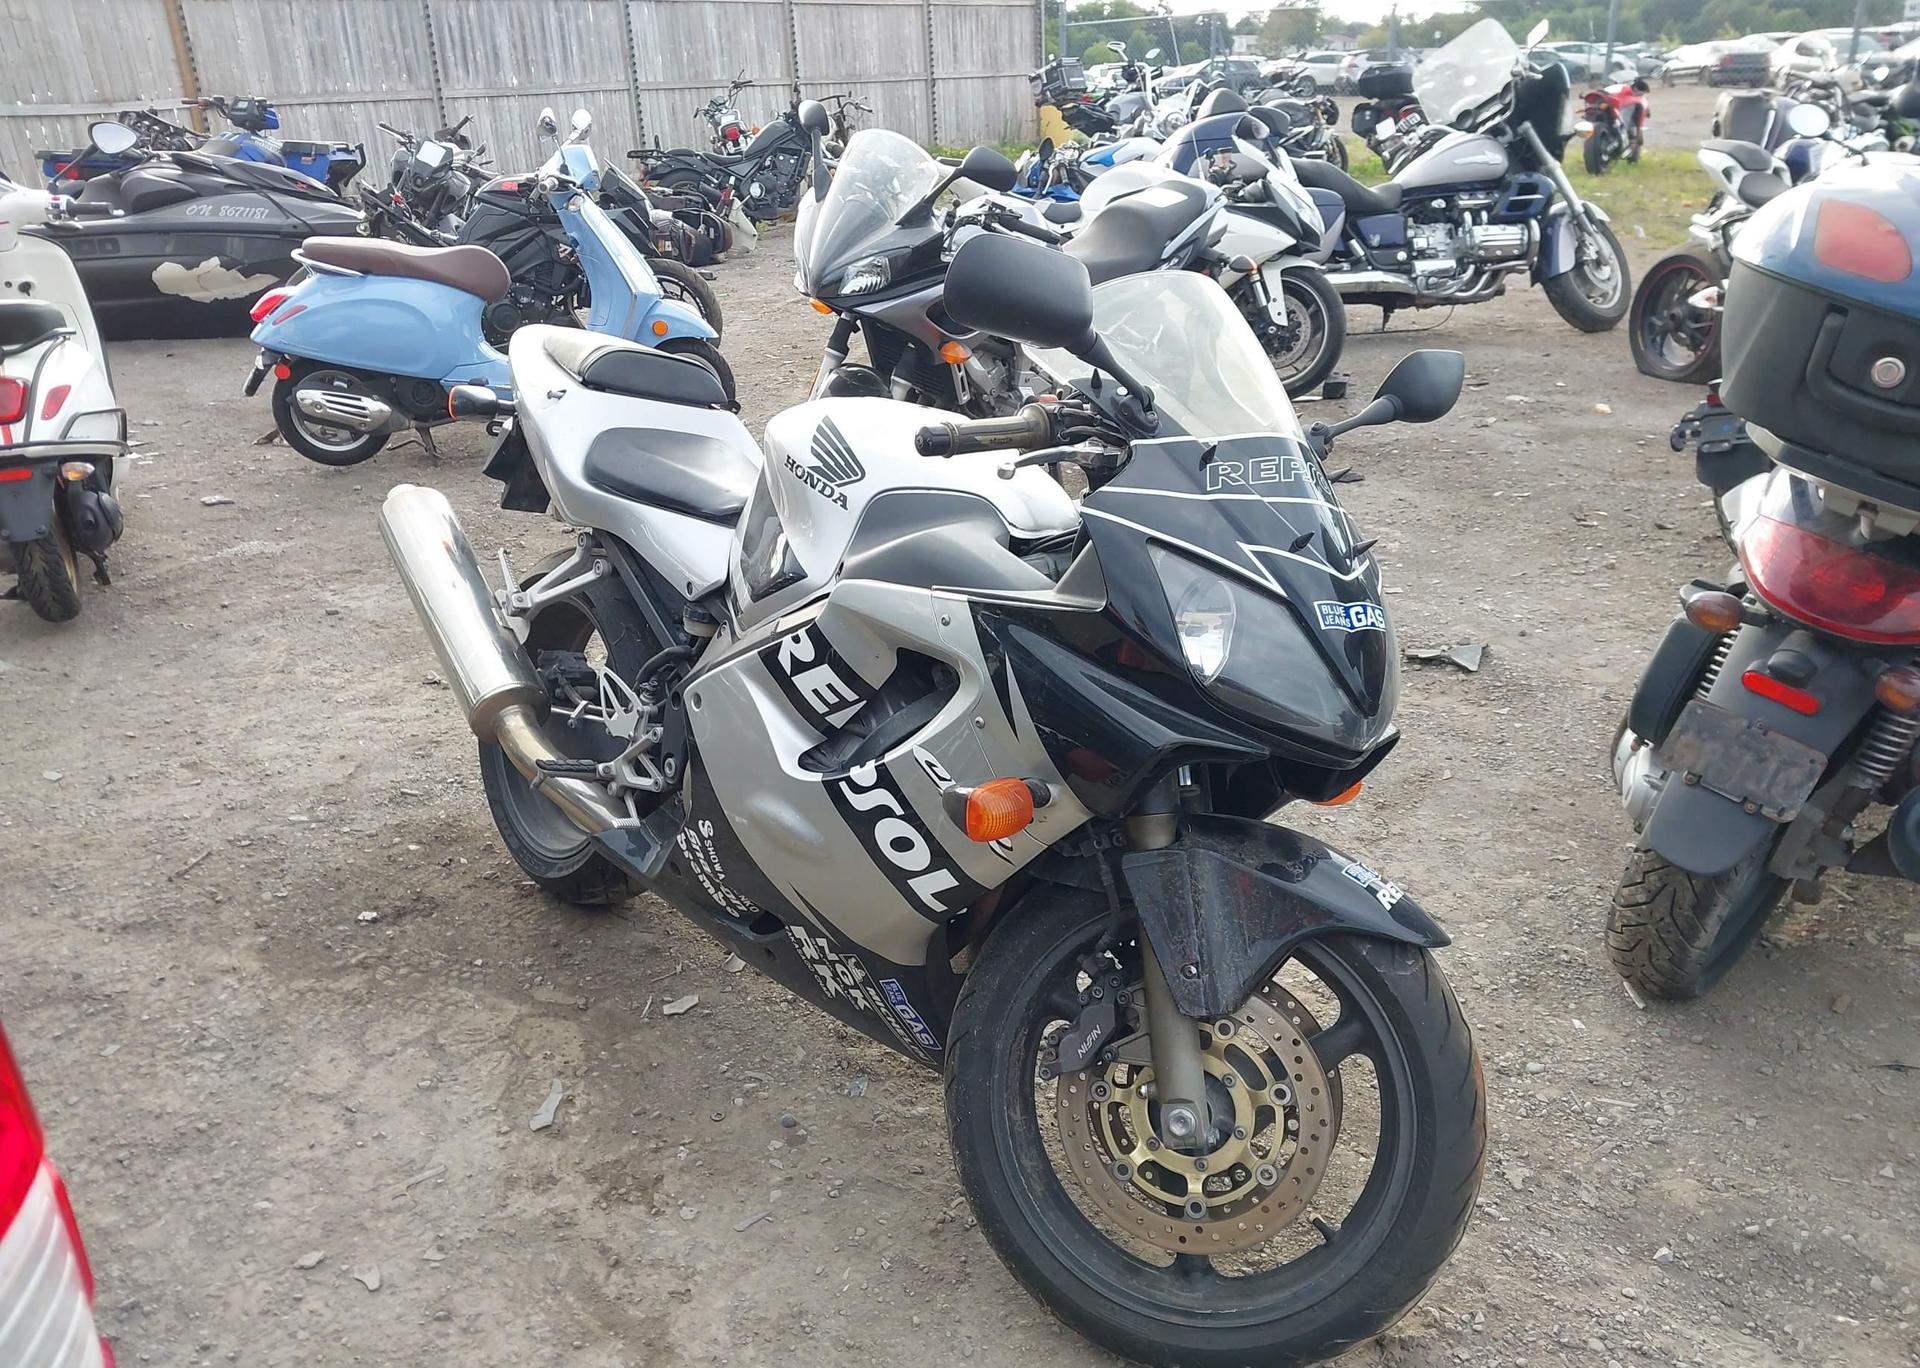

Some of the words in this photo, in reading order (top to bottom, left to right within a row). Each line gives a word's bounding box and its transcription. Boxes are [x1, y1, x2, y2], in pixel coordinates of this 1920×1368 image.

[784, 454, 849, 511] HONDA
[1321, 604, 1347, 617] BLUE
[1324, 614, 1351, 628] JEANS
[1350, 605, 1386, 629] GAS
[704, 839, 726, 880] SHOWA
[789, 925, 849, 999] RK
[815, 937, 875, 1011] NGK
[889, 983, 905, 1004] BLUE
[865, 986, 930, 1061] MICHELIN
[895, 1004, 934, 1045] GAS
[1077, 1023, 1102, 1059] NISSIN
